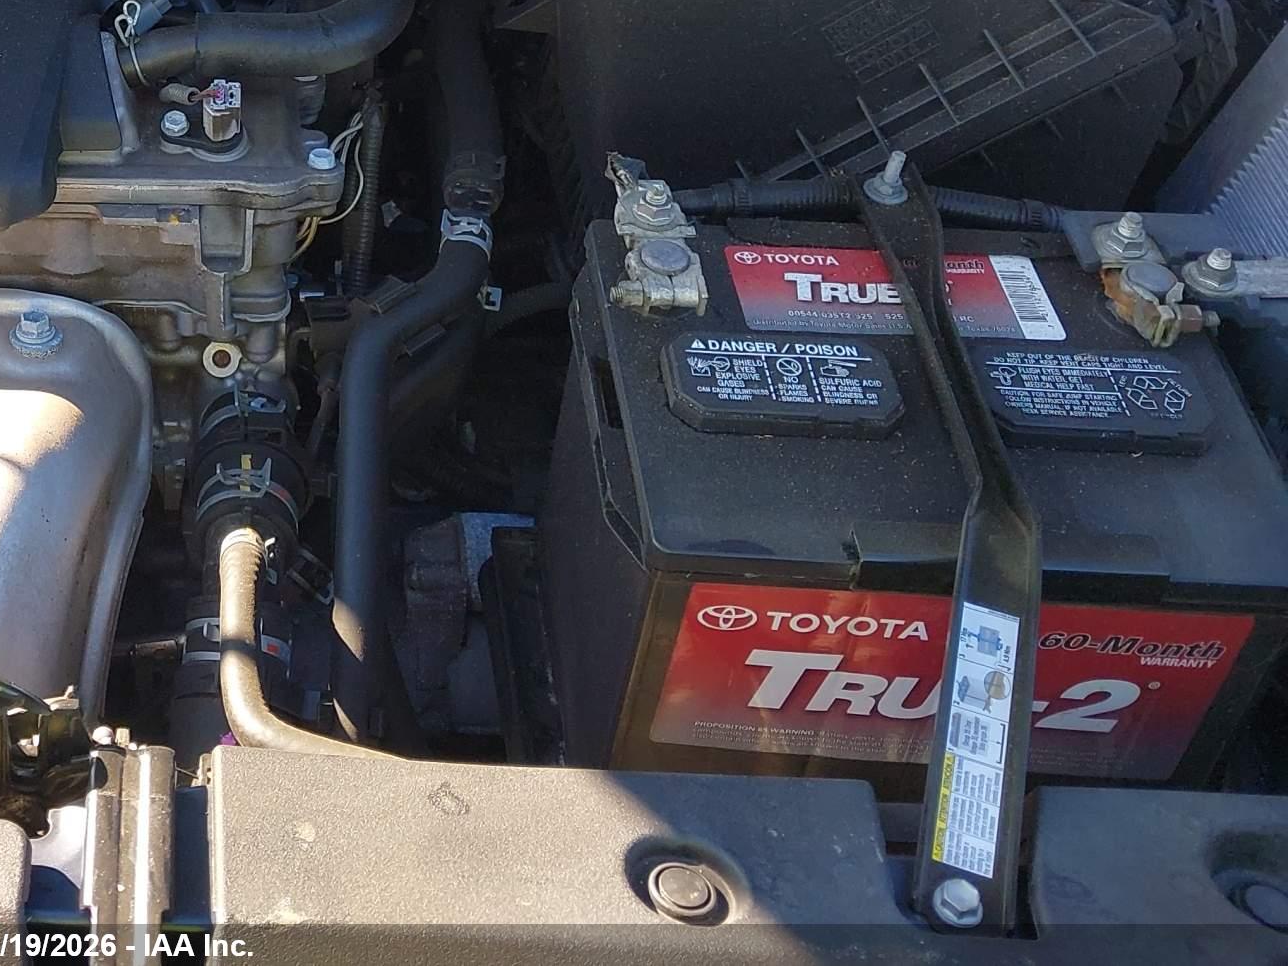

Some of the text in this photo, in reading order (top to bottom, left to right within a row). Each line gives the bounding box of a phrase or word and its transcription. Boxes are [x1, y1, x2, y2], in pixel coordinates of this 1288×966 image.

[765, 253, 839, 266] TOYOTA
[708, 339, 778, 353] DANGER
[795, 343, 859, 357] POISON
[732, 358, 763, 367] SHIELD
[715, 371, 762, 381] EXPLOSIVE
[783, 376, 799, 384] NO
[818, 377, 882, 387] SULFURIC ACID
[766, 610, 929, 642] TOYOTA
[1039, 632, 1227, 661] 60-Month
[1140, 656, 1217, 669] WARRANTY
